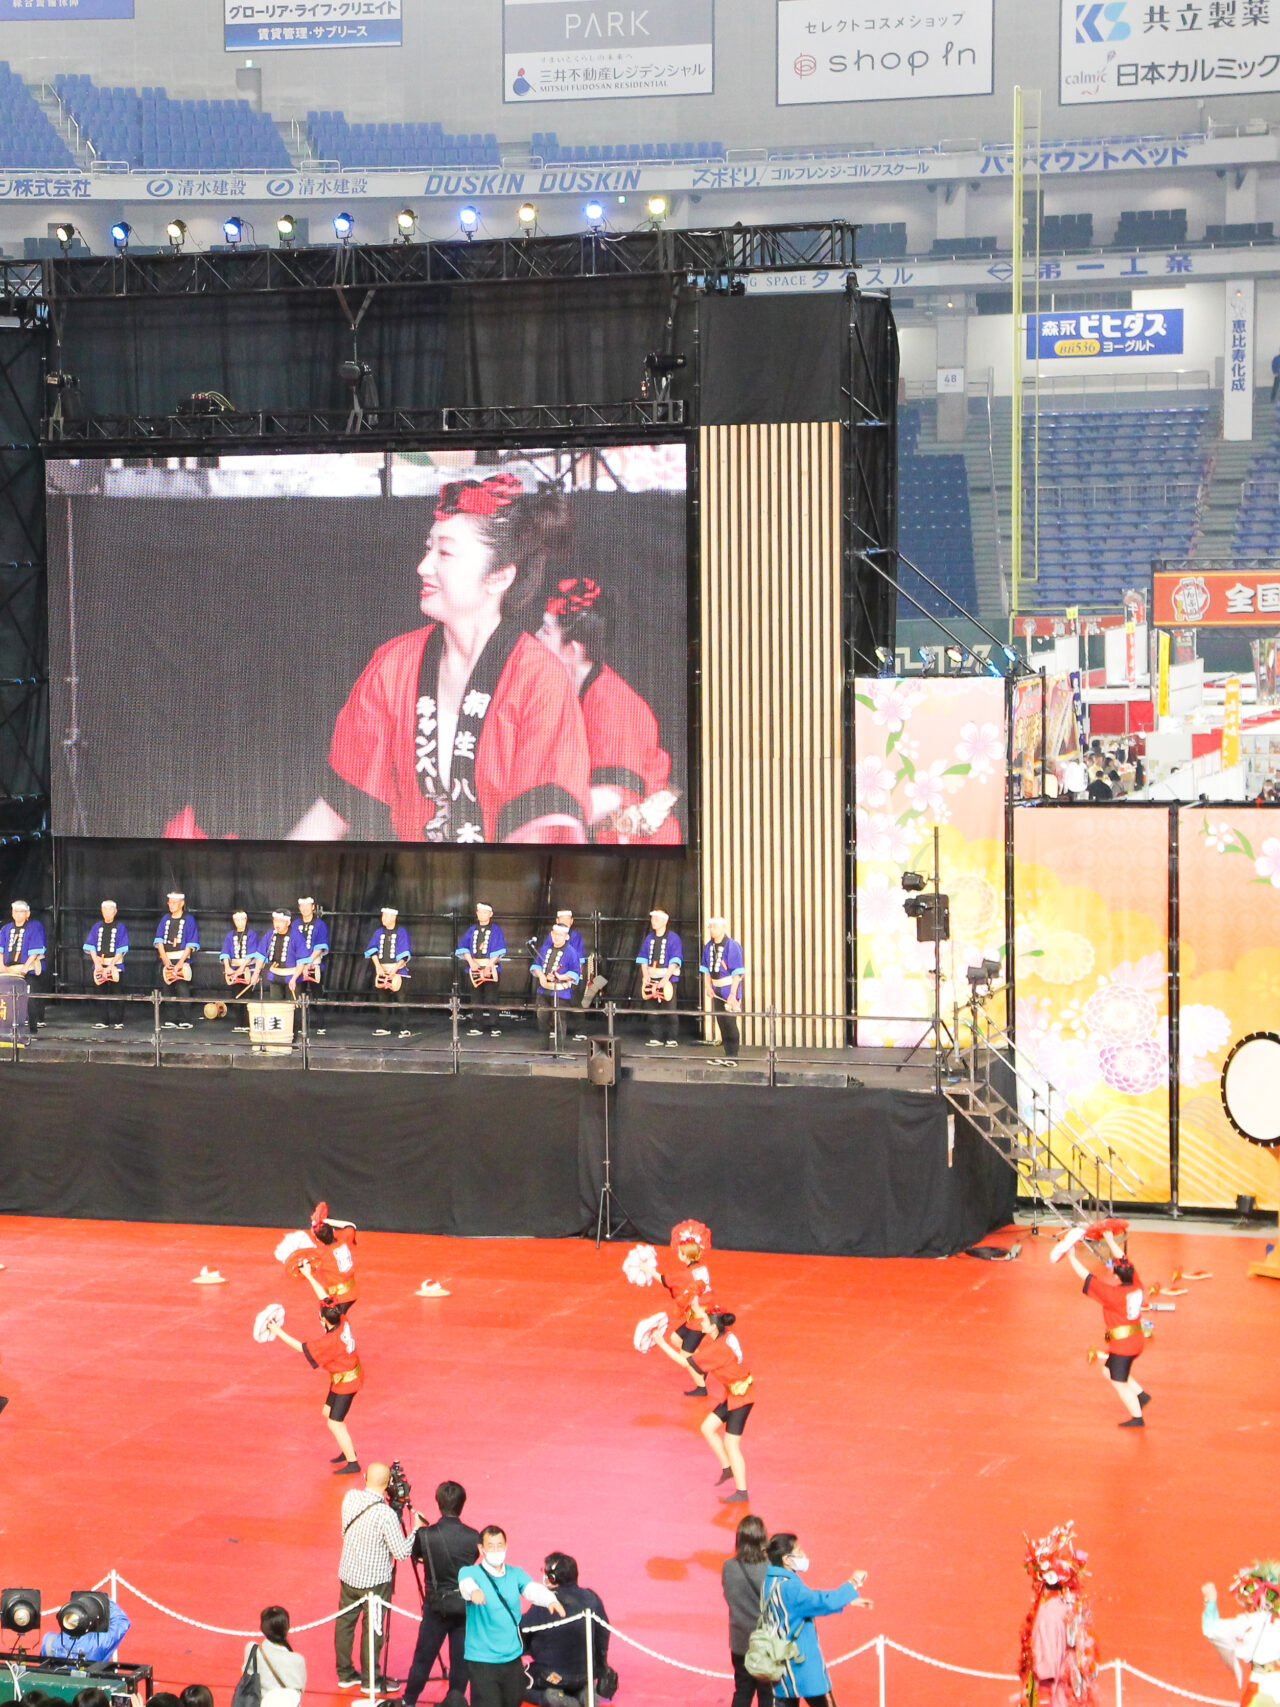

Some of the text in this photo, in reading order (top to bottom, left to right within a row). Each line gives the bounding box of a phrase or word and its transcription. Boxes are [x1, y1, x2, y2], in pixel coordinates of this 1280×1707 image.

[229, 1, 397, 19] グローリア・ライフ・クリエイト
[1144, 0, 1269, 33] 共立製薬
[565, 10, 650, 39] PARK
[805, 12, 965, 34] セレクトコスメショップ
[258, 26, 368, 41] 賃貸管理・サブリース
[829, 49, 929, 76] shop
[1117, 55, 1280, 86] 日本カルミック
[539, 64, 705, 83] 三井不動産レジデンシャル
[1065, 71, 1108, 85] calmic
[571, 83, 613, 91] FUDOSAN
[614, 80, 668, 89] RESIDENTIAL
[178, 179, 246, 196] 清水建設
[299, 178, 367, 195] 清水建設
[766, 276, 807, 287] SPACE
[1041, 312, 1167, 339] 森永 ビヒダス
[1103, 340, 1155, 353] ヨーグルト
[944, 374, 957, 383] 48
[1225, 583, 1280, 612] 全国
[253, 1015, 282, 1031] 桐生
